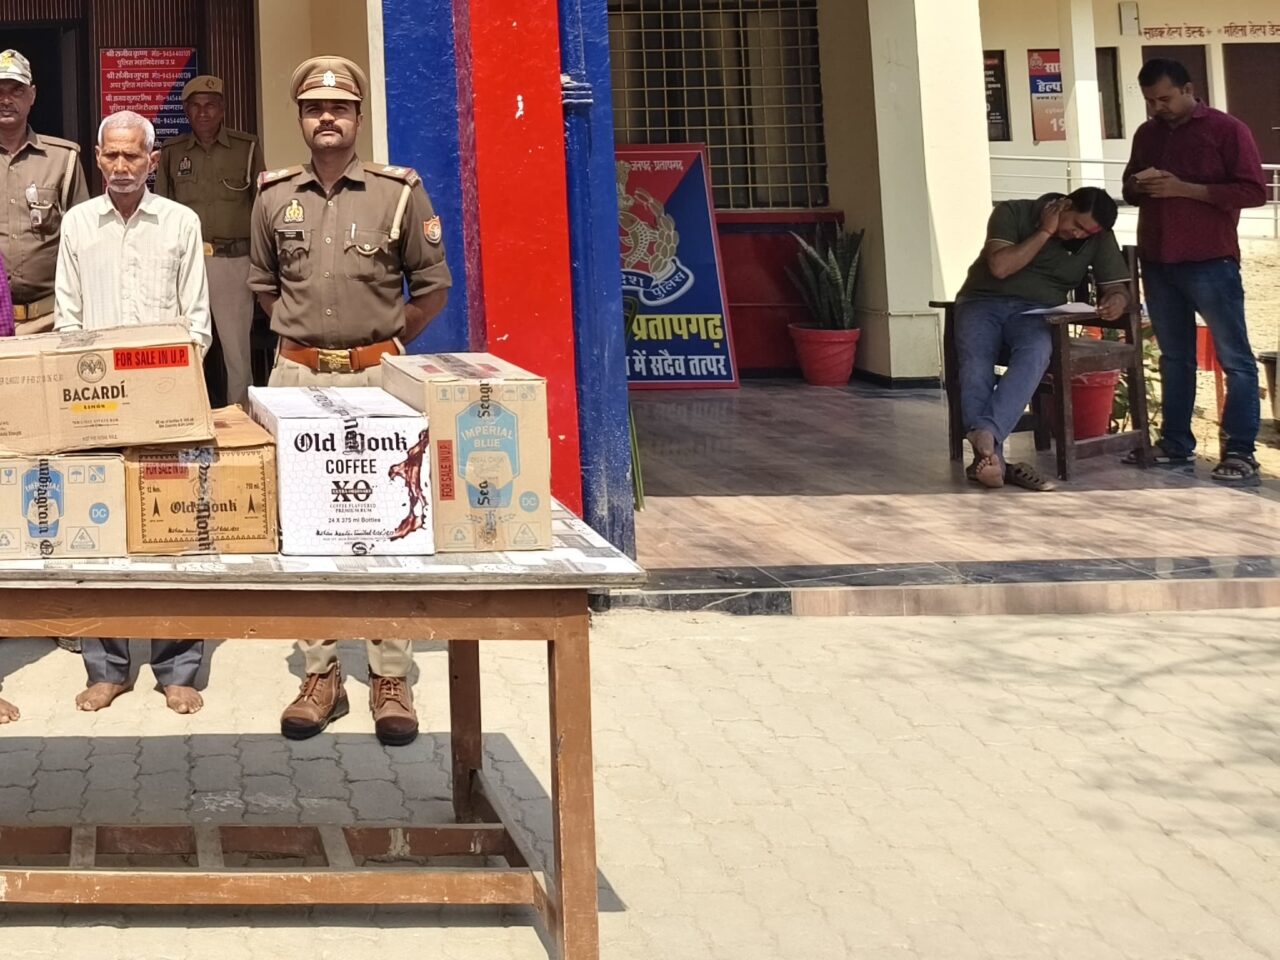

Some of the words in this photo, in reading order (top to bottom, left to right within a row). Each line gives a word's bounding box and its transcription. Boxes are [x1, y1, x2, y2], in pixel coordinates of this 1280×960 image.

[651, 271, 686, 300] पुलिस
[631, 313, 724, 349] प्रतापगढ़
[115, 351, 133, 367] FOR
[134, 349, 156, 366] SALE
[158, 349, 168, 365] IN
[170, 349, 187, 364] U.P.
[631, 349, 647, 377] में
[649, 349, 685, 376] सदैव
[688, 355, 727, 376] तत्पर
[62, 380, 126, 402] BACARDÍ
[461, 425, 513, 441] IMPERIAL
[294, 432, 337, 454] Old
[473, 439, 500, 449] BLUE
[325, 459, 377, 474] COFFEE
[441, 464, 452, 483] SALE
[331, 479, 373, 503] XO
[441, 484, 452, 497] FOR
[522, 496, 537, 506] DC
[91, 508, 108, 518] DC
